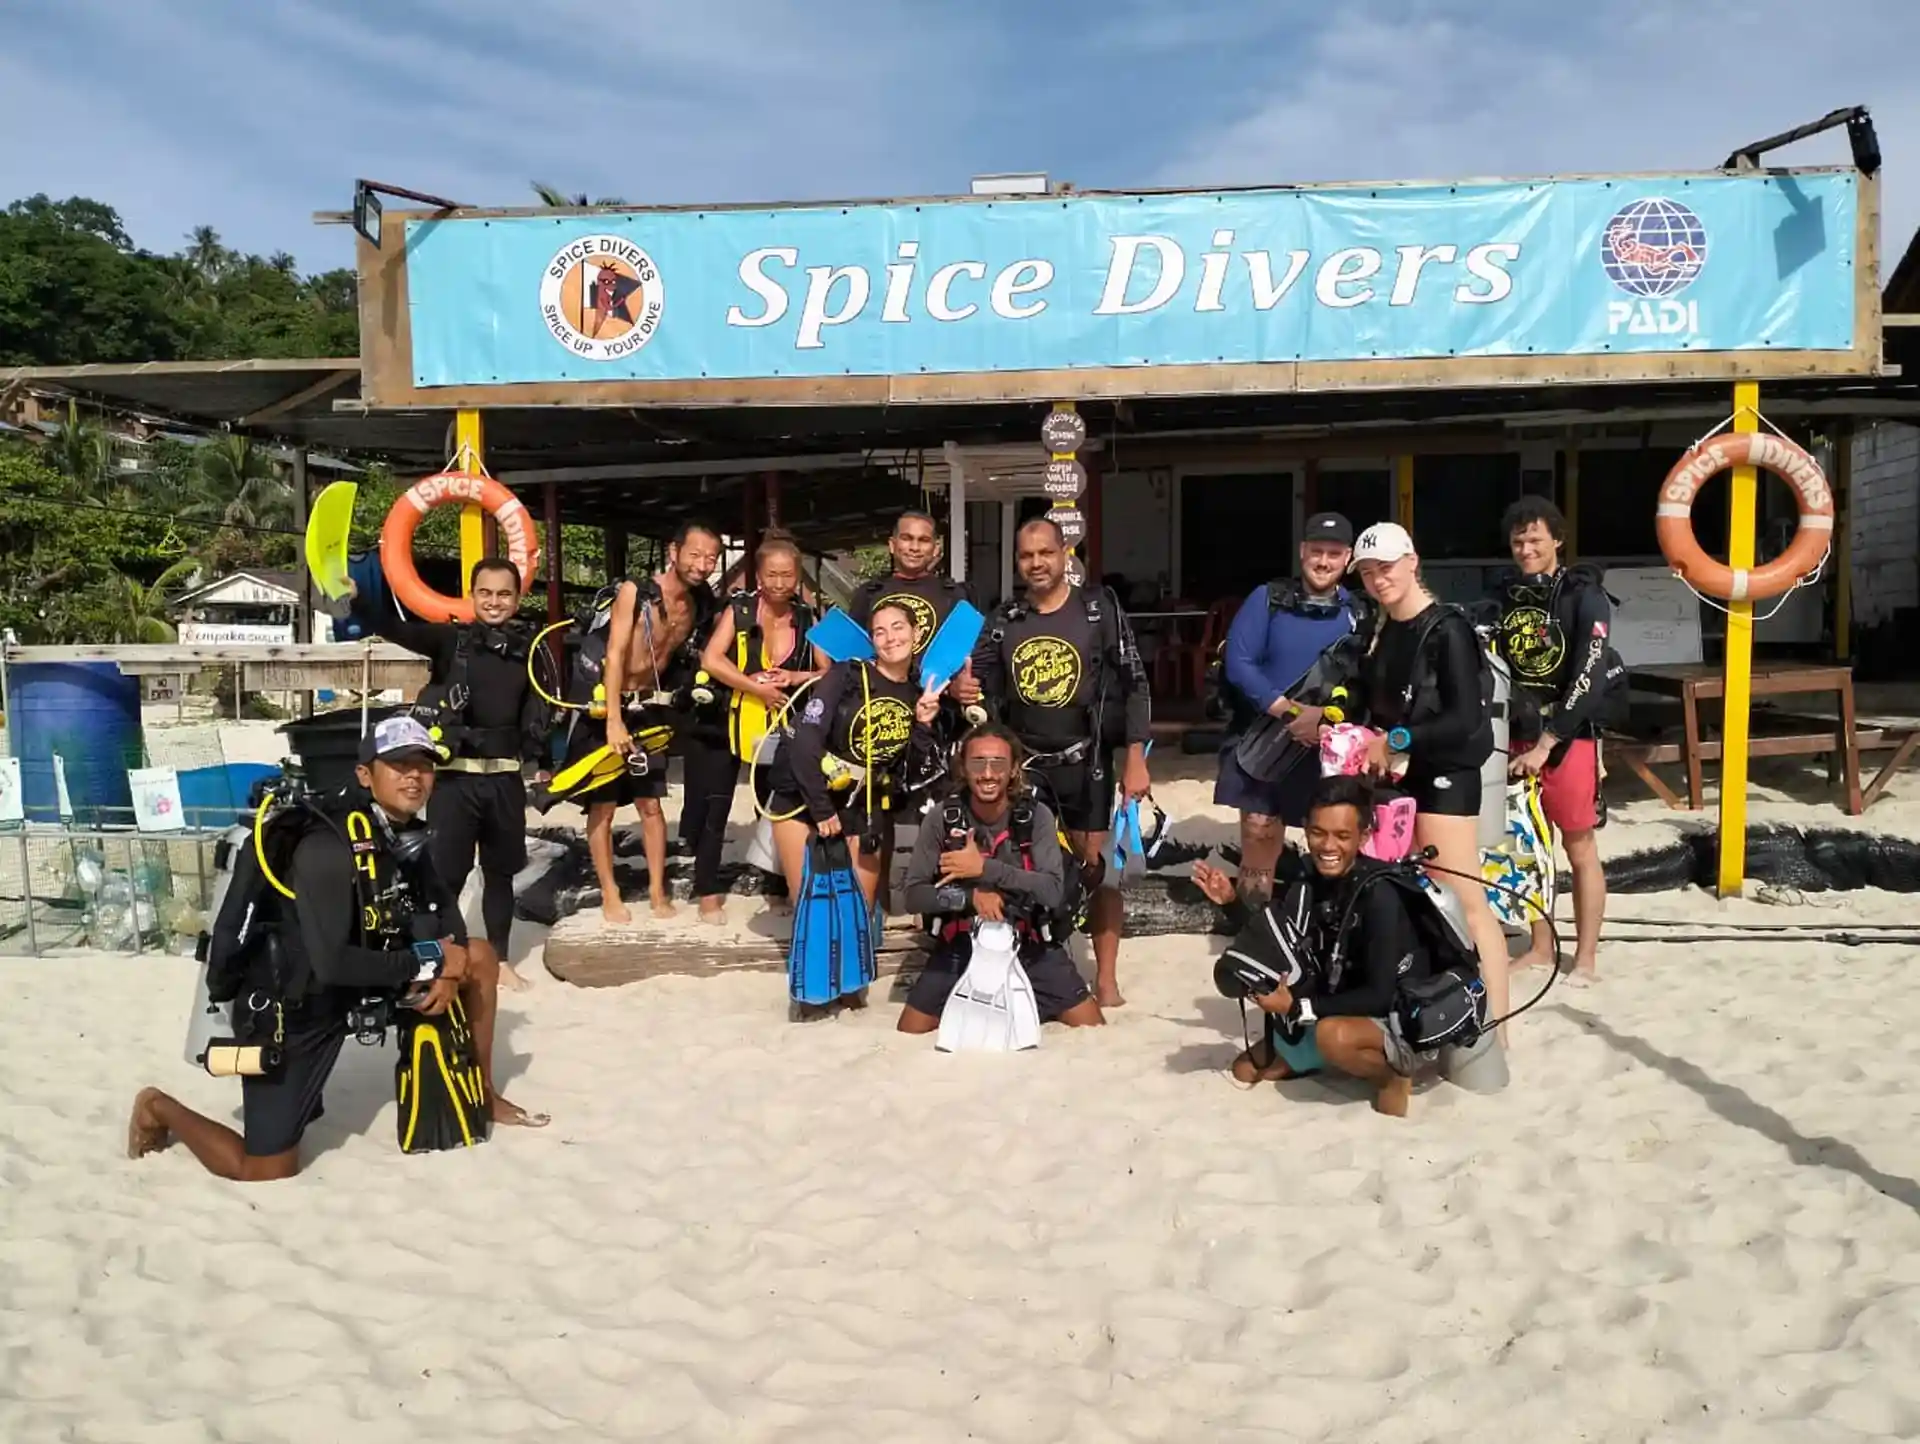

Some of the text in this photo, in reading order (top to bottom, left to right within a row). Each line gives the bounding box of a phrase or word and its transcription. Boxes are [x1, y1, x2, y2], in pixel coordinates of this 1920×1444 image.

[550, 239, 655, 282] SPICE DIVERS
[725, 228, 1521, 349] Spice Divers
[544, 301, 660, 356] SPICE UP YOUR DIVE
[1607, 299, 1698, 335] PADI
[1666, 439, 1830, 509] SPICE DIVERS
[416, 476, 528, 579] SPICE DIVE
